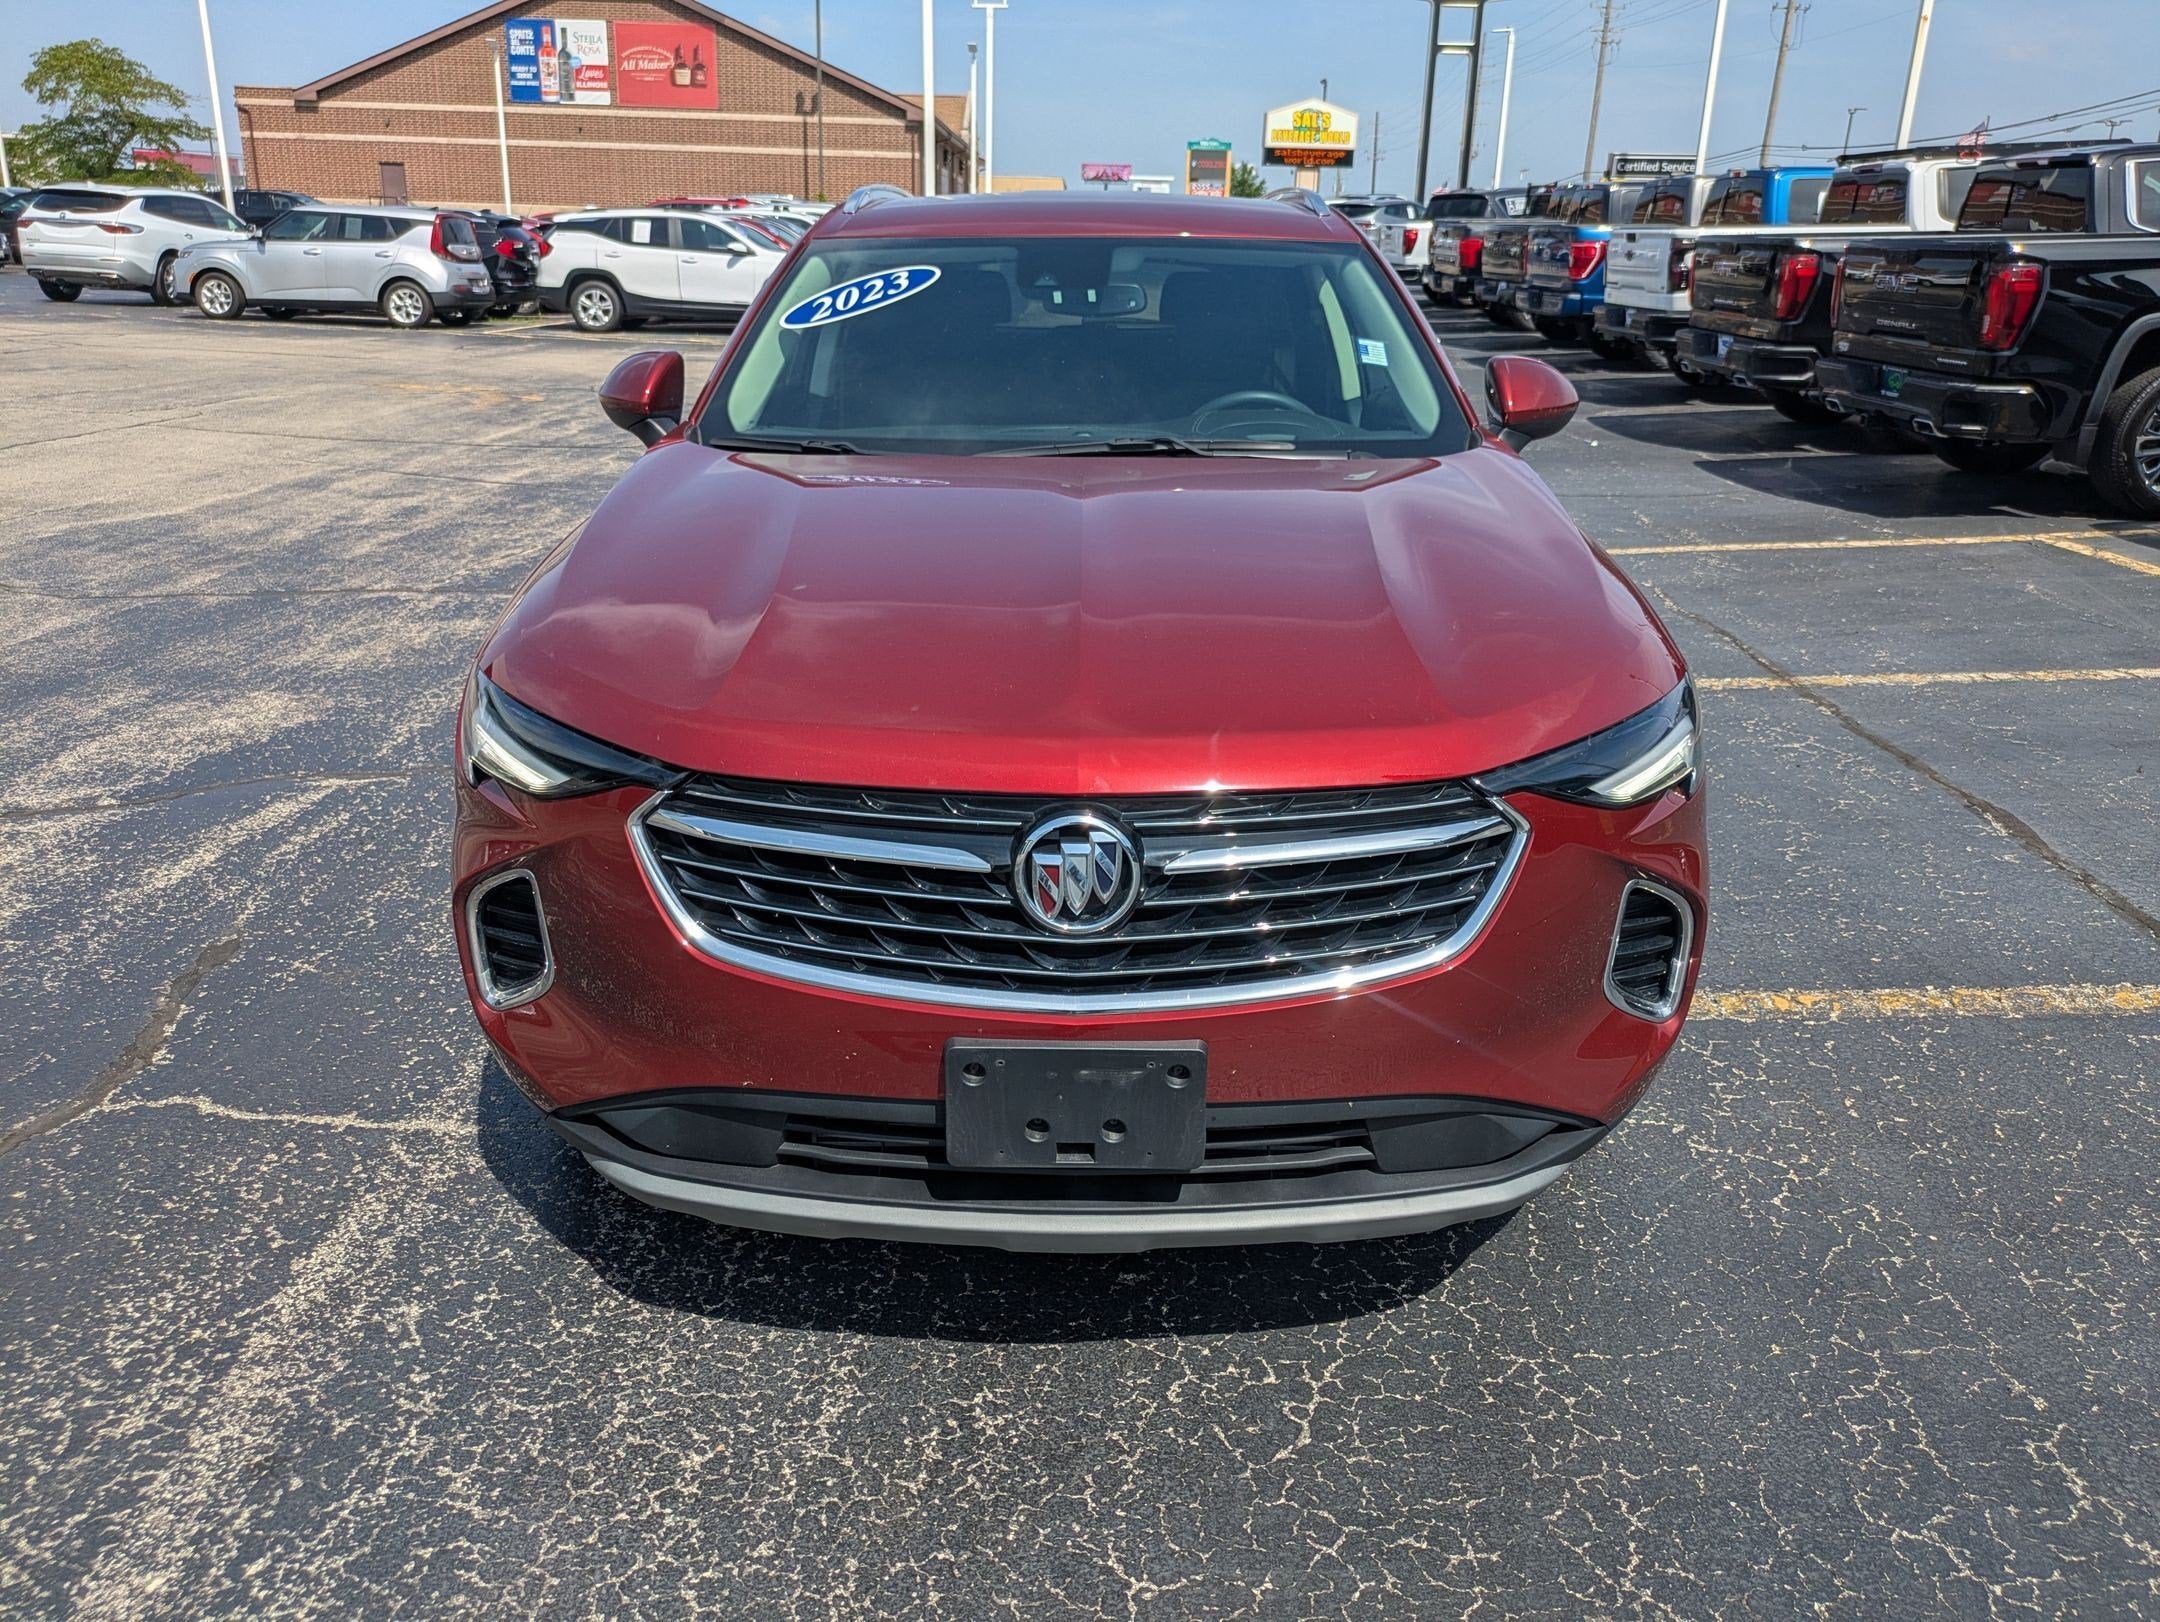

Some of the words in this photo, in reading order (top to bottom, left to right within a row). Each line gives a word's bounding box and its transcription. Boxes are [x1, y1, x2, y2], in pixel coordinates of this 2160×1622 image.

[573, 31, 603, 44] STELLA
[576, 44, 601, 56] ROSA
[620, 59, 637, 70] All
[579, 65, 604, 80] Loves
[576, 80, 608, 88] ILLINOIS
[1271, 129, 1317, 144] BEVERAGE
[1320, 130, 1351, 145] WORLD
[1274, 149, 1346, 159] salsbeverage
[1283, 157, 1336, 165] world.com
[1617, 161, 1659, 172] Certified
[1661, 161, 1696, 172] Service
[1873, 273, 1919, 294] GMC
[809, 270, 910, 322] 2023
[1876, 318, 1916, 329] DENALI
